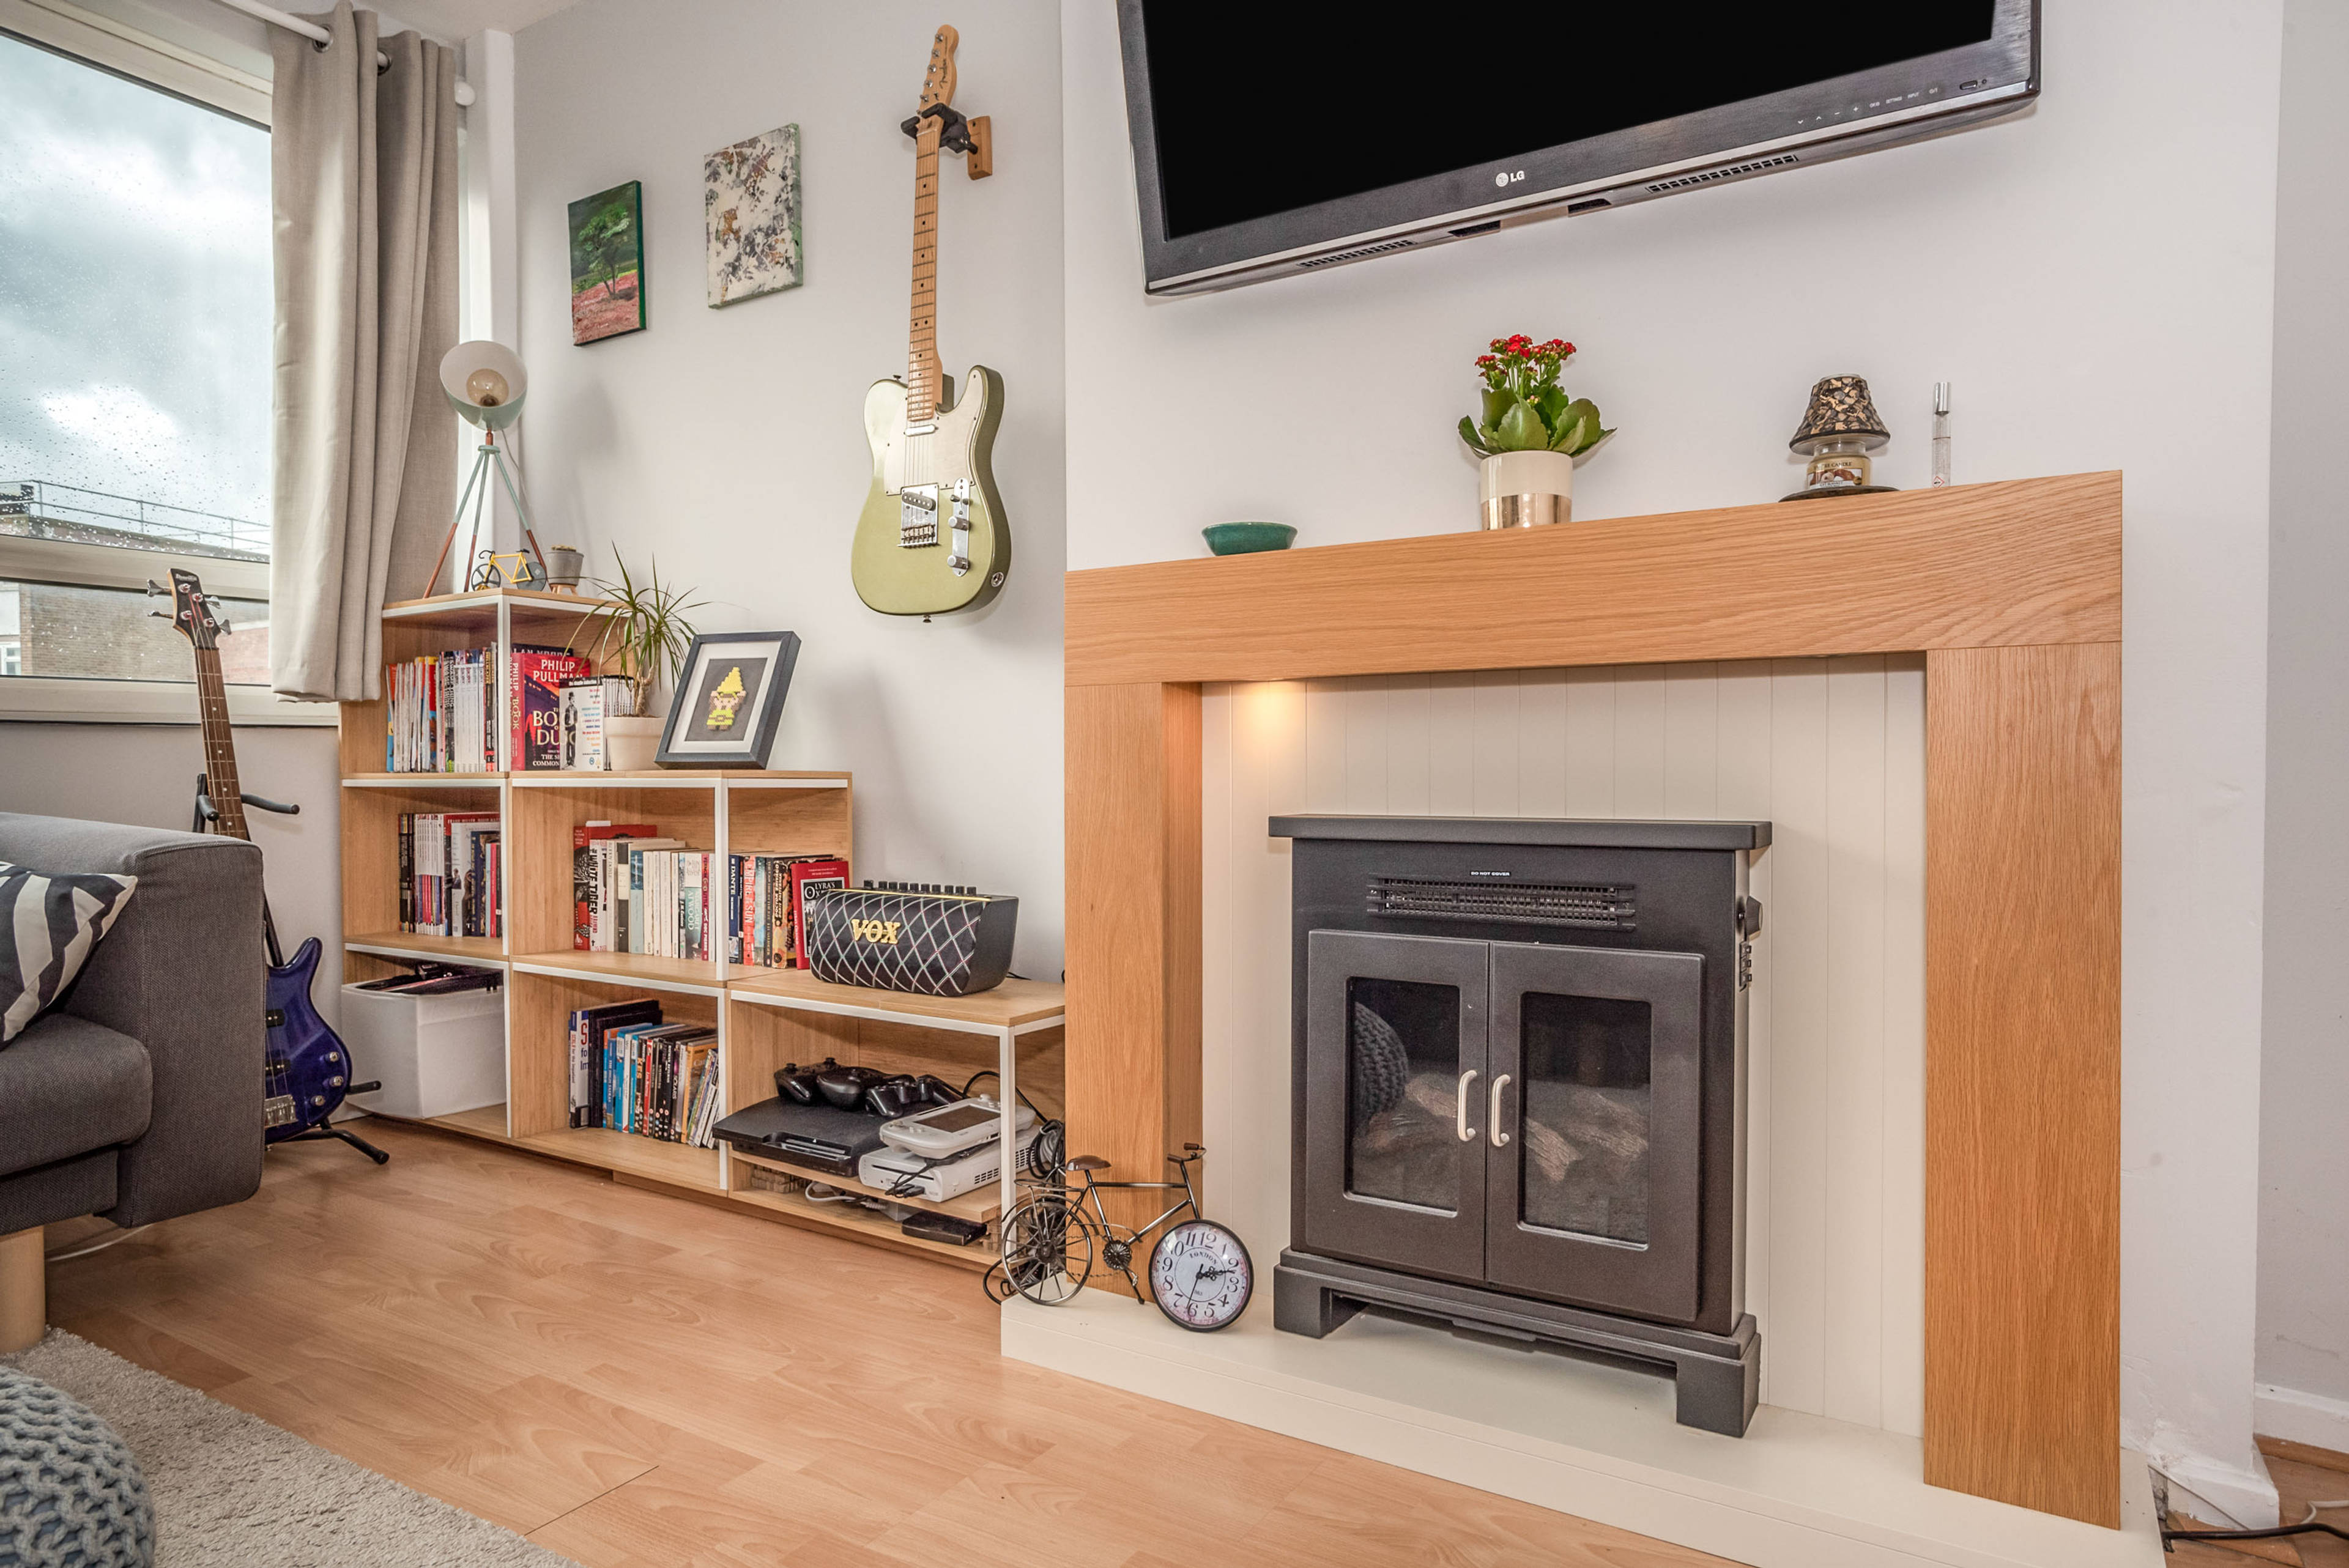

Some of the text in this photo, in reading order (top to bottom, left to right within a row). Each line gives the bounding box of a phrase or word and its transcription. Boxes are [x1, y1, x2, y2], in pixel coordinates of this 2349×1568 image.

[1510, 170, 1525, 182] LG
[541, 659, 575, 671] PHILIP
[533, 710, 559, 727] BO
[536, 730, 559, 745] DU
[589, 855, 598, 914] WHITE TIGER
[744, 864, 754, 897] EMPIRE
[815, 881, 836, 890] LYRA'S
[744, 905, 754, 923] SUN
[851, 919, 900, 945] VOX
[1186, 1232, 1197, 1246] 11
[1200, 1231, 1217, 1249] 12
[1162, 1257, 1173, 1272] 9
[1190, 1251, 1217, 1265] LONDON
[1228, 1257, 1239, 1274] 2
[1163, 1275, 1174, 1292] 8
[1227, 1277, 1240, 1293] 3
[1173, 1293, 1184, 1307] 7
[1218, 1293, 1230, 1307] 4
[1187, 1302, 1199, 1317] 6
[1204, 1302, 1215, 1317] 5
